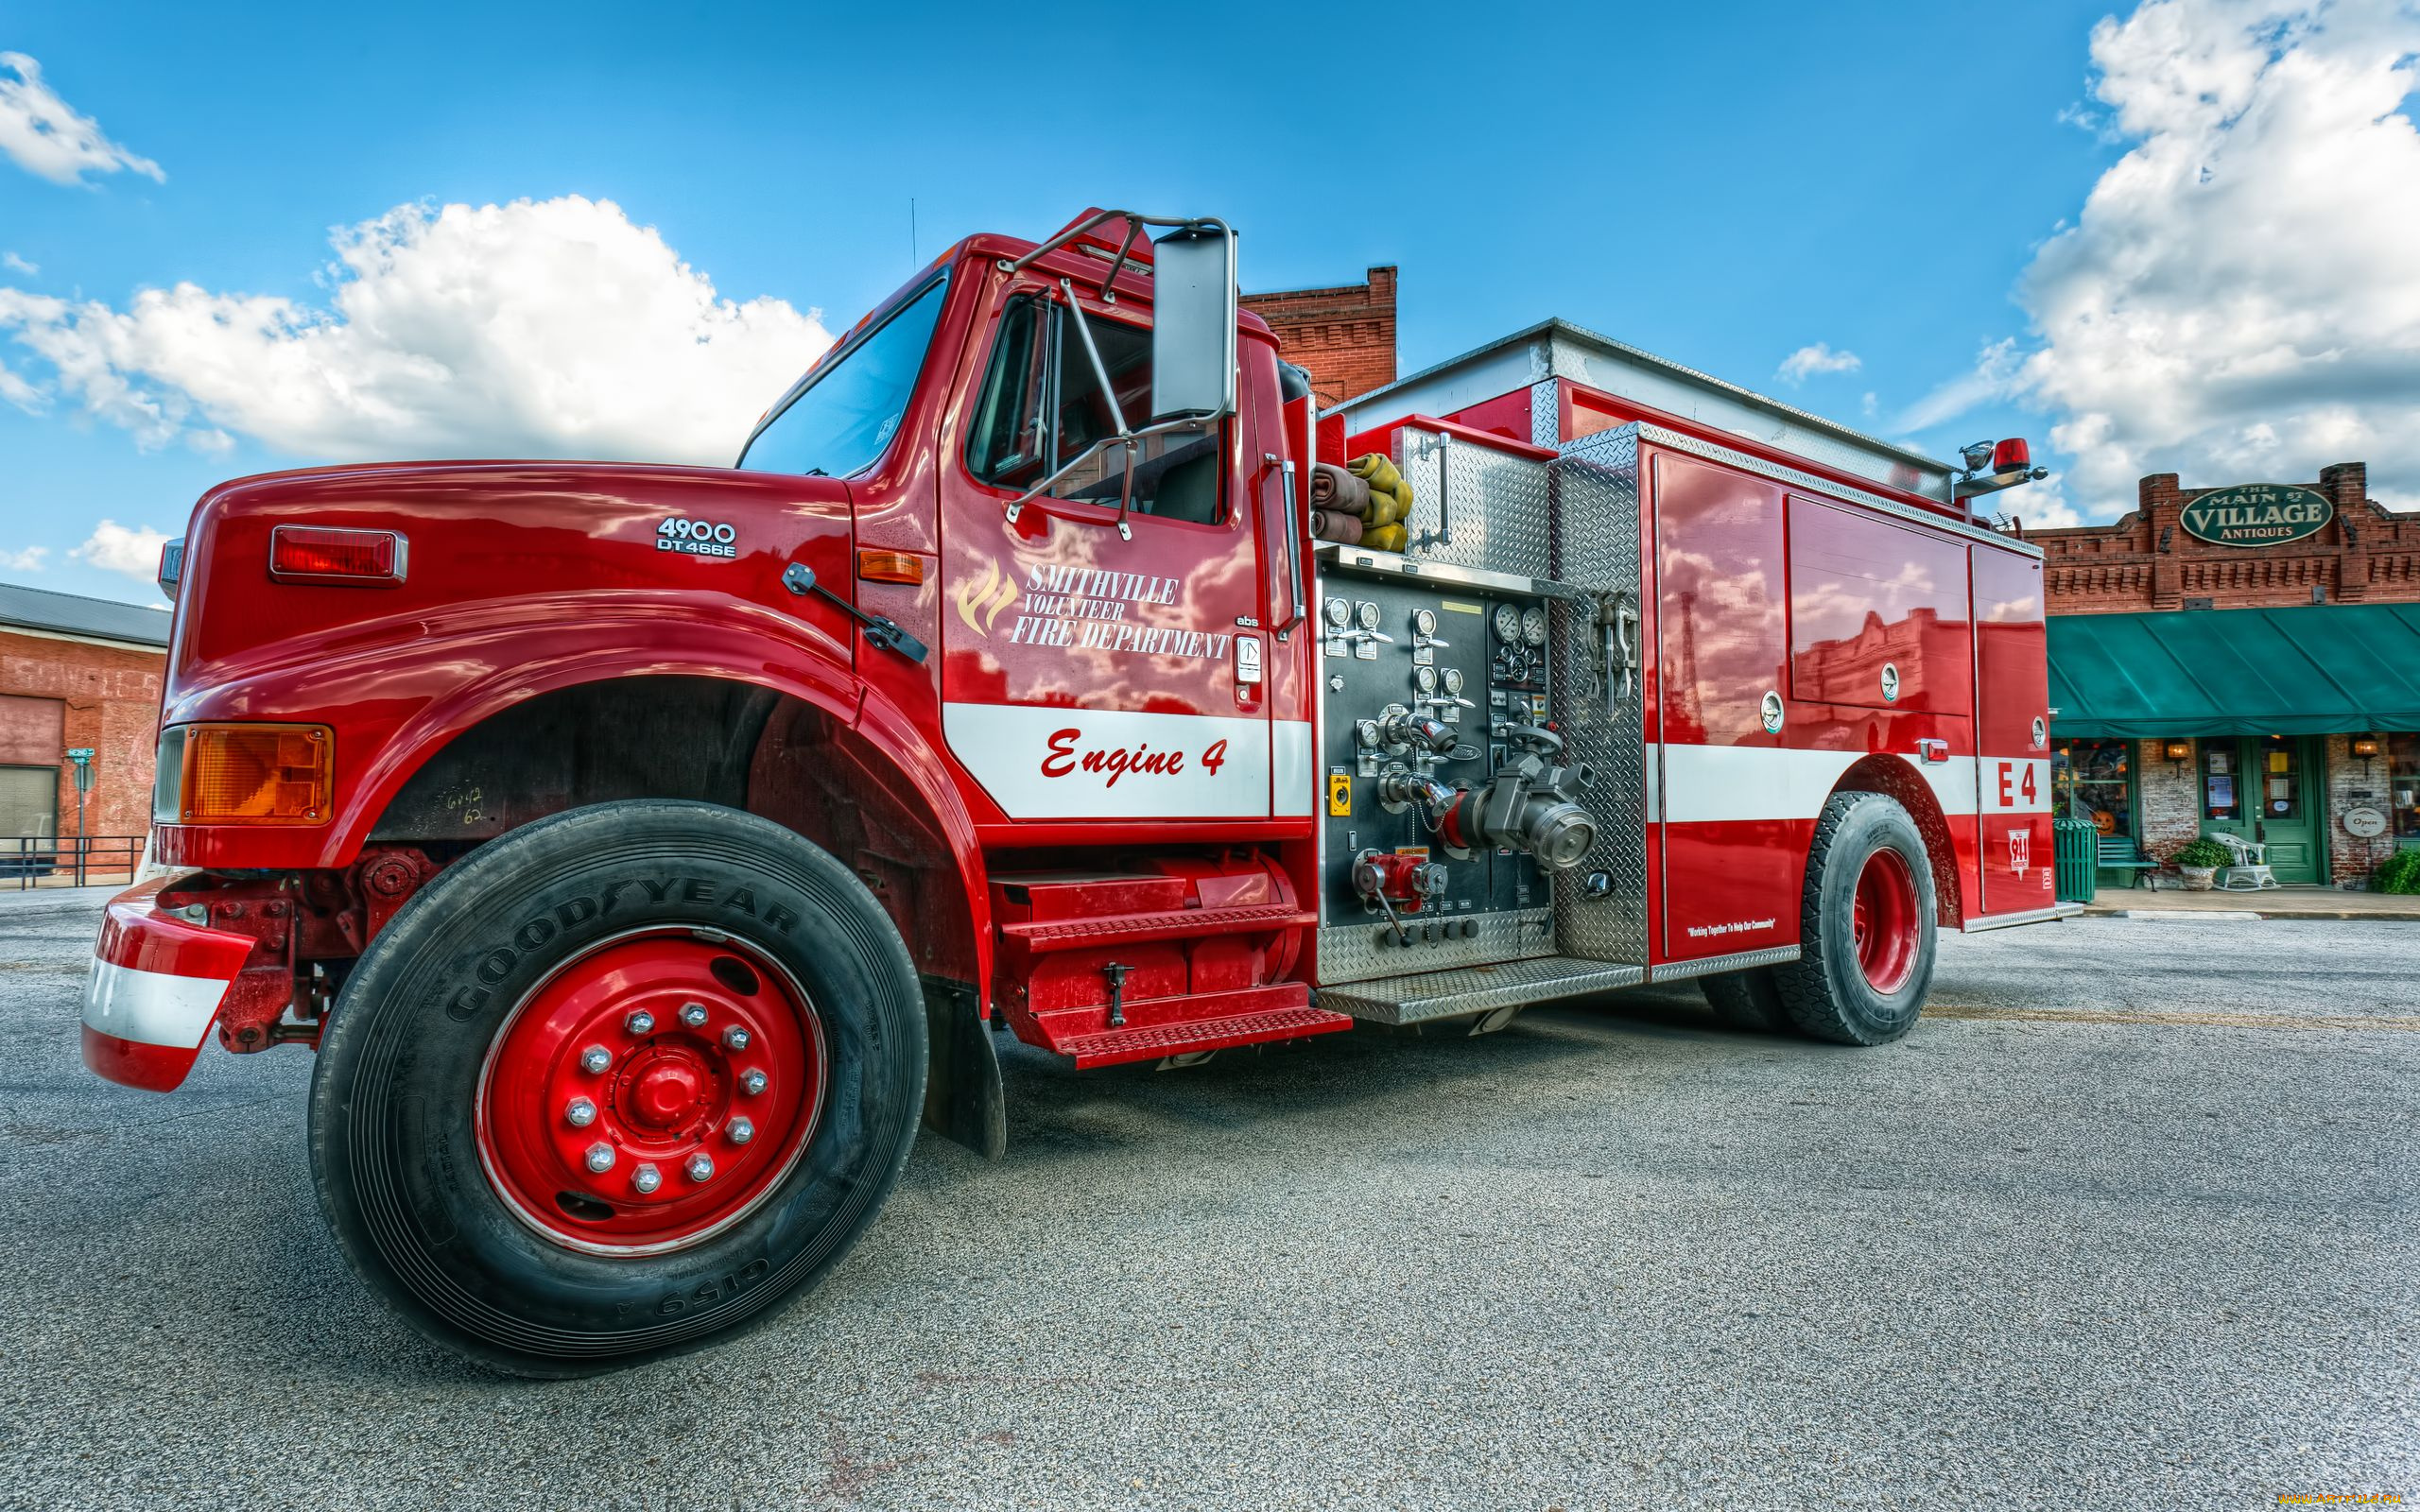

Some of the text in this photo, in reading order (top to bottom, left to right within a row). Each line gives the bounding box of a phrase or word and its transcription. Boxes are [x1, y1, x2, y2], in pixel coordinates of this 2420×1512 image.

[2208, 491, 2305, 507] MAIN ST
[657, 517, 736, 543] 4900
[2188, 504, 2323, 535] VILLAGE
[2221, 526, 2293, 540] ANTIQUES
[657, 539, 736, 558] DT 466E
[1026, 563, 1179, 606] SMITHVILLE
[1024, 594, 1125, 621] VOLUNTEER
[1236, 615, 1259, 627] abs
[1009, 615, 1231, 660] FIRE DEPARTMENT
[1040, 728, 1228, 788] Engine 4
[2353, 817, 2377, 827] Open
[1708, 925, 1727, 936] Together
[1727, 922, 1734, 933] To
[1734, 922, 1743, 933] Help
[445, 877, 802, 1022] GOODYEAR
[654, 1258, 769, 1316] G159
